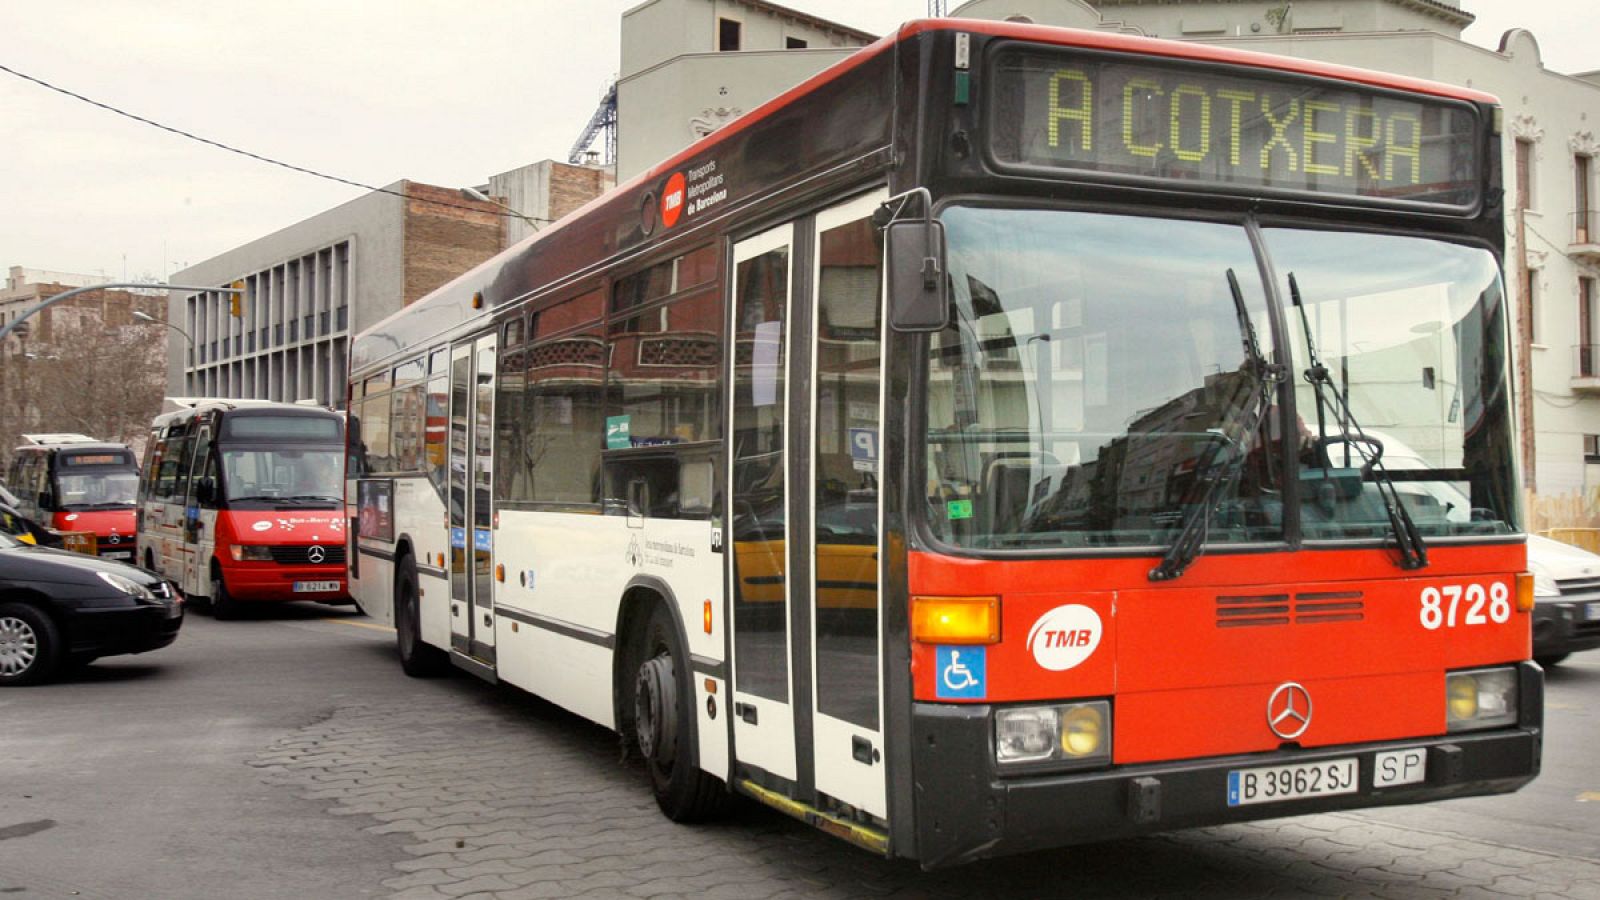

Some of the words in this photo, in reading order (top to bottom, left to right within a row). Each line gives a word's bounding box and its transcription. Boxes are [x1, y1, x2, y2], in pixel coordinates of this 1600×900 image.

[1048, 70, 1092, 151] A
[1123, 79, 1420, 184] COTXERA
[689, 160, 715, 181] Transports
[688, 174, 724, 198] Metropolitans
[688, 203, 695, 215] de
[696, 189, 727, 211] Barcelona
[1420, 581, 1510, 630] 8728
[1045, 629, 1092, 648] TMB
[1244, 772, 1258, 799] B
[1264, 767, 1323, 797] 3962
[1327, 763, 1353, 790] SJ
